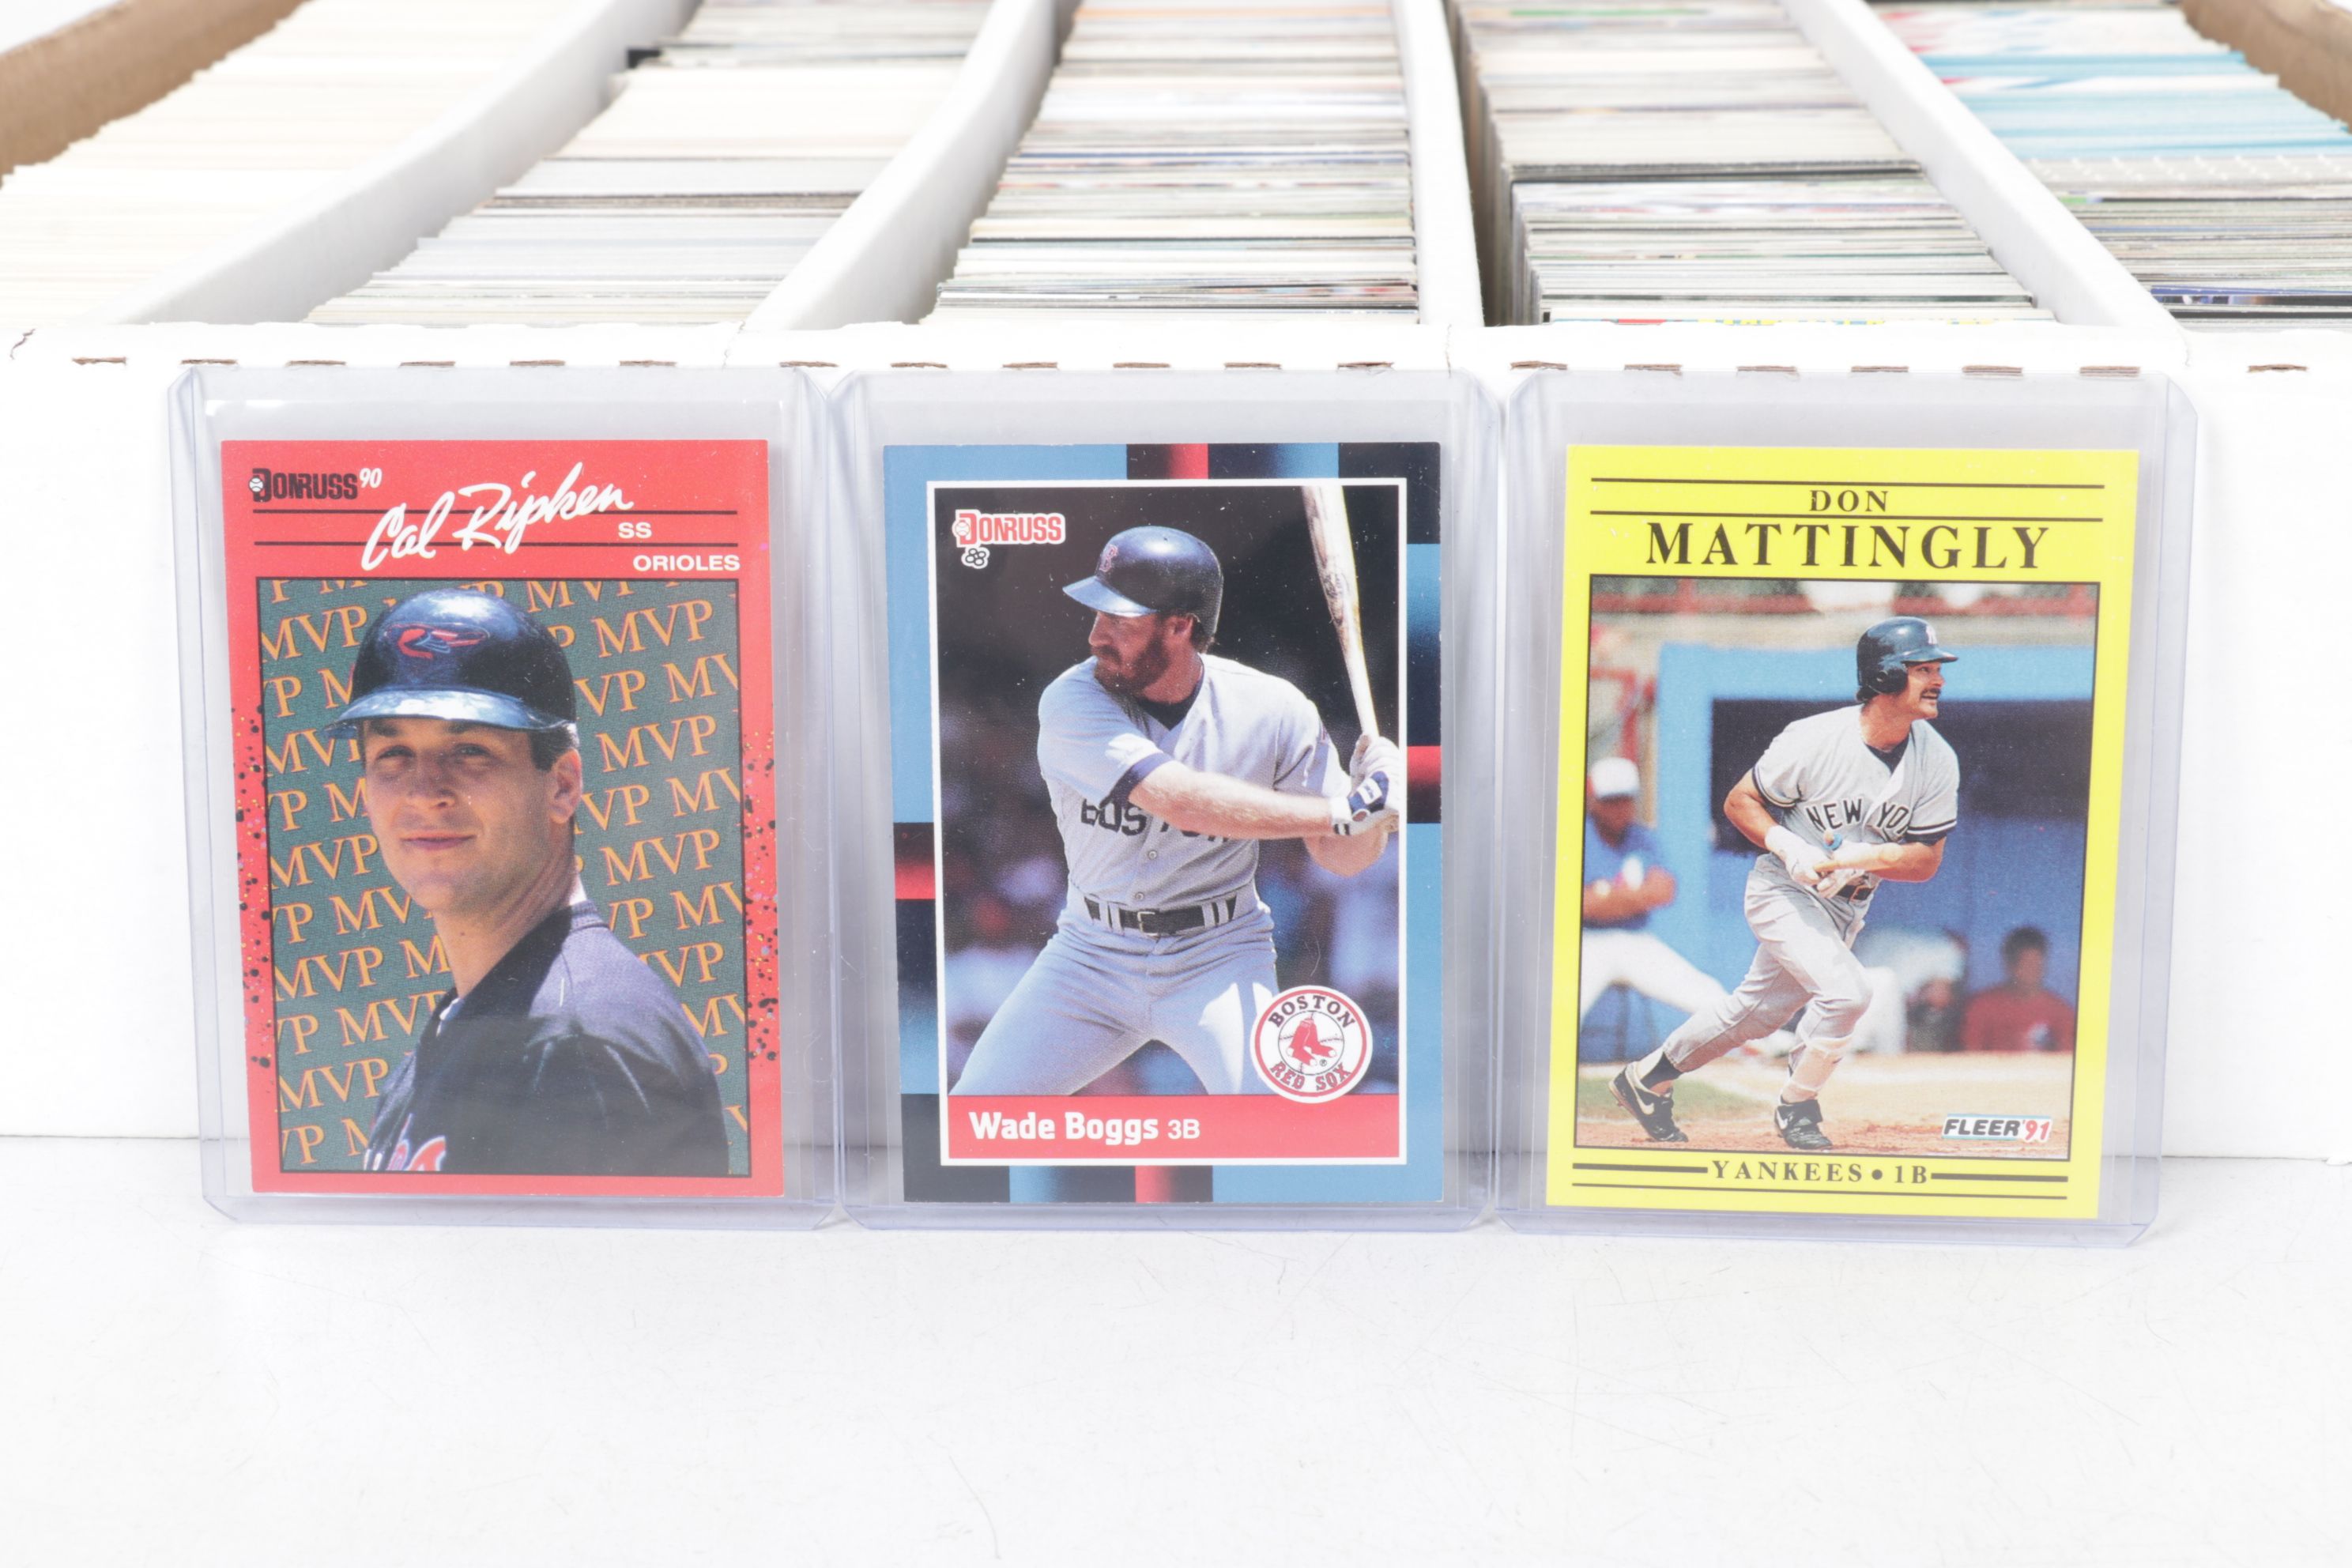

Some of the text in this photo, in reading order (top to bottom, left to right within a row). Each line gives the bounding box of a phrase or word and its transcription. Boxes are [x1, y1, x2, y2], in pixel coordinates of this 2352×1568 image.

[249, 467, 383, 503] DONRUSS 90
[1809, 489, 1889, 513] DON
[360, 462, 634, 571] Cal Ripken
[617, 522, 653, 539] SS
[953, 511, 1062, 545] DONRUSS
[1645, 522, 2049, 569] MATTINGLY
[632, 555, 741, 572] ORIOLES
[591, 599, 713, 658] MVP
[596, 714, 718, 773] MVP
[1805, 798, 1863, 833] NEW
[599, 829, 722, 887] MVP
[1268, 995, 1355, 1028] BOSTON
[1270, 1061, 1353, 1091] RED SOX
[968, 1111, 1200, 1146] Wade Boggs 3B
[1712, 1160, 1927, 1184] YANKEES 1B
